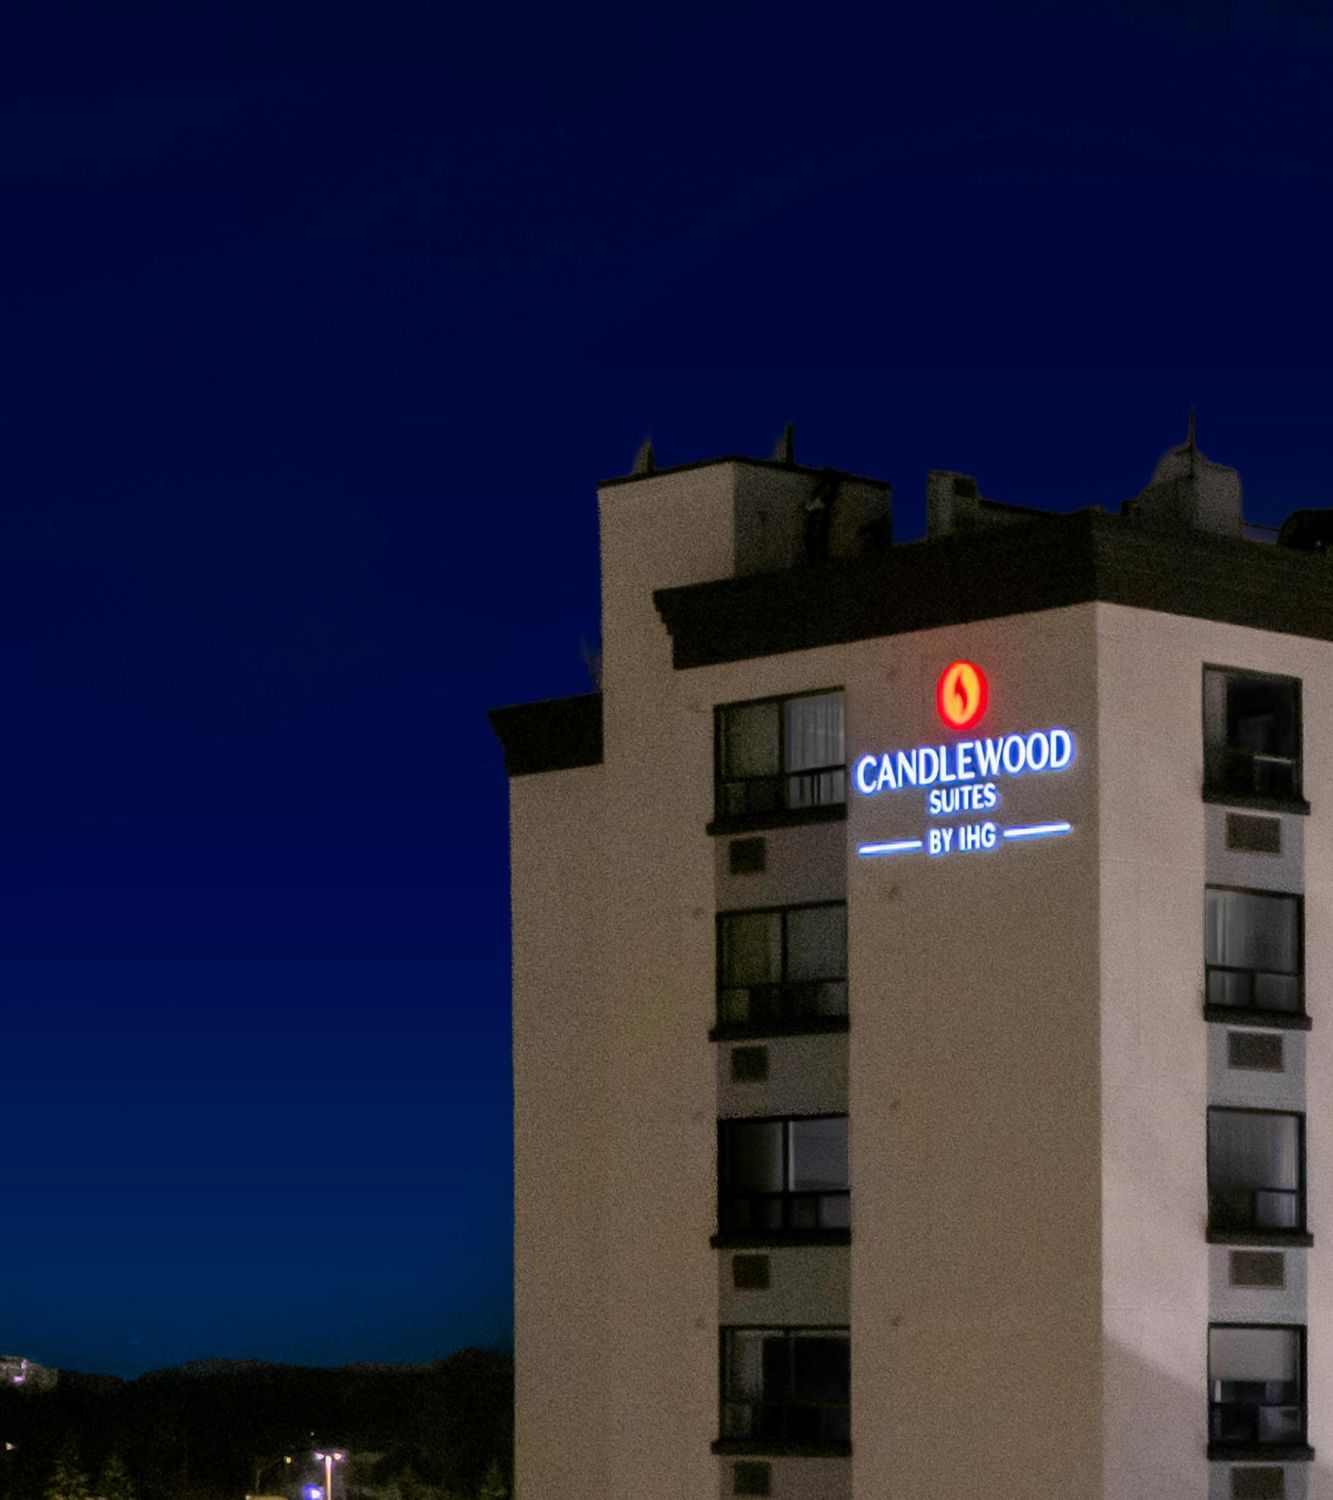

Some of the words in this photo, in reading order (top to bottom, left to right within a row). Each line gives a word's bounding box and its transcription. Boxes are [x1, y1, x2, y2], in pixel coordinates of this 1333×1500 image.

[856, 729, 1073, 794] CANDLEWOOD
[929, 783, 997, 814] SUITES
[929, 828, 953, 855] BY
[959, 822, 996, 851] IHG
